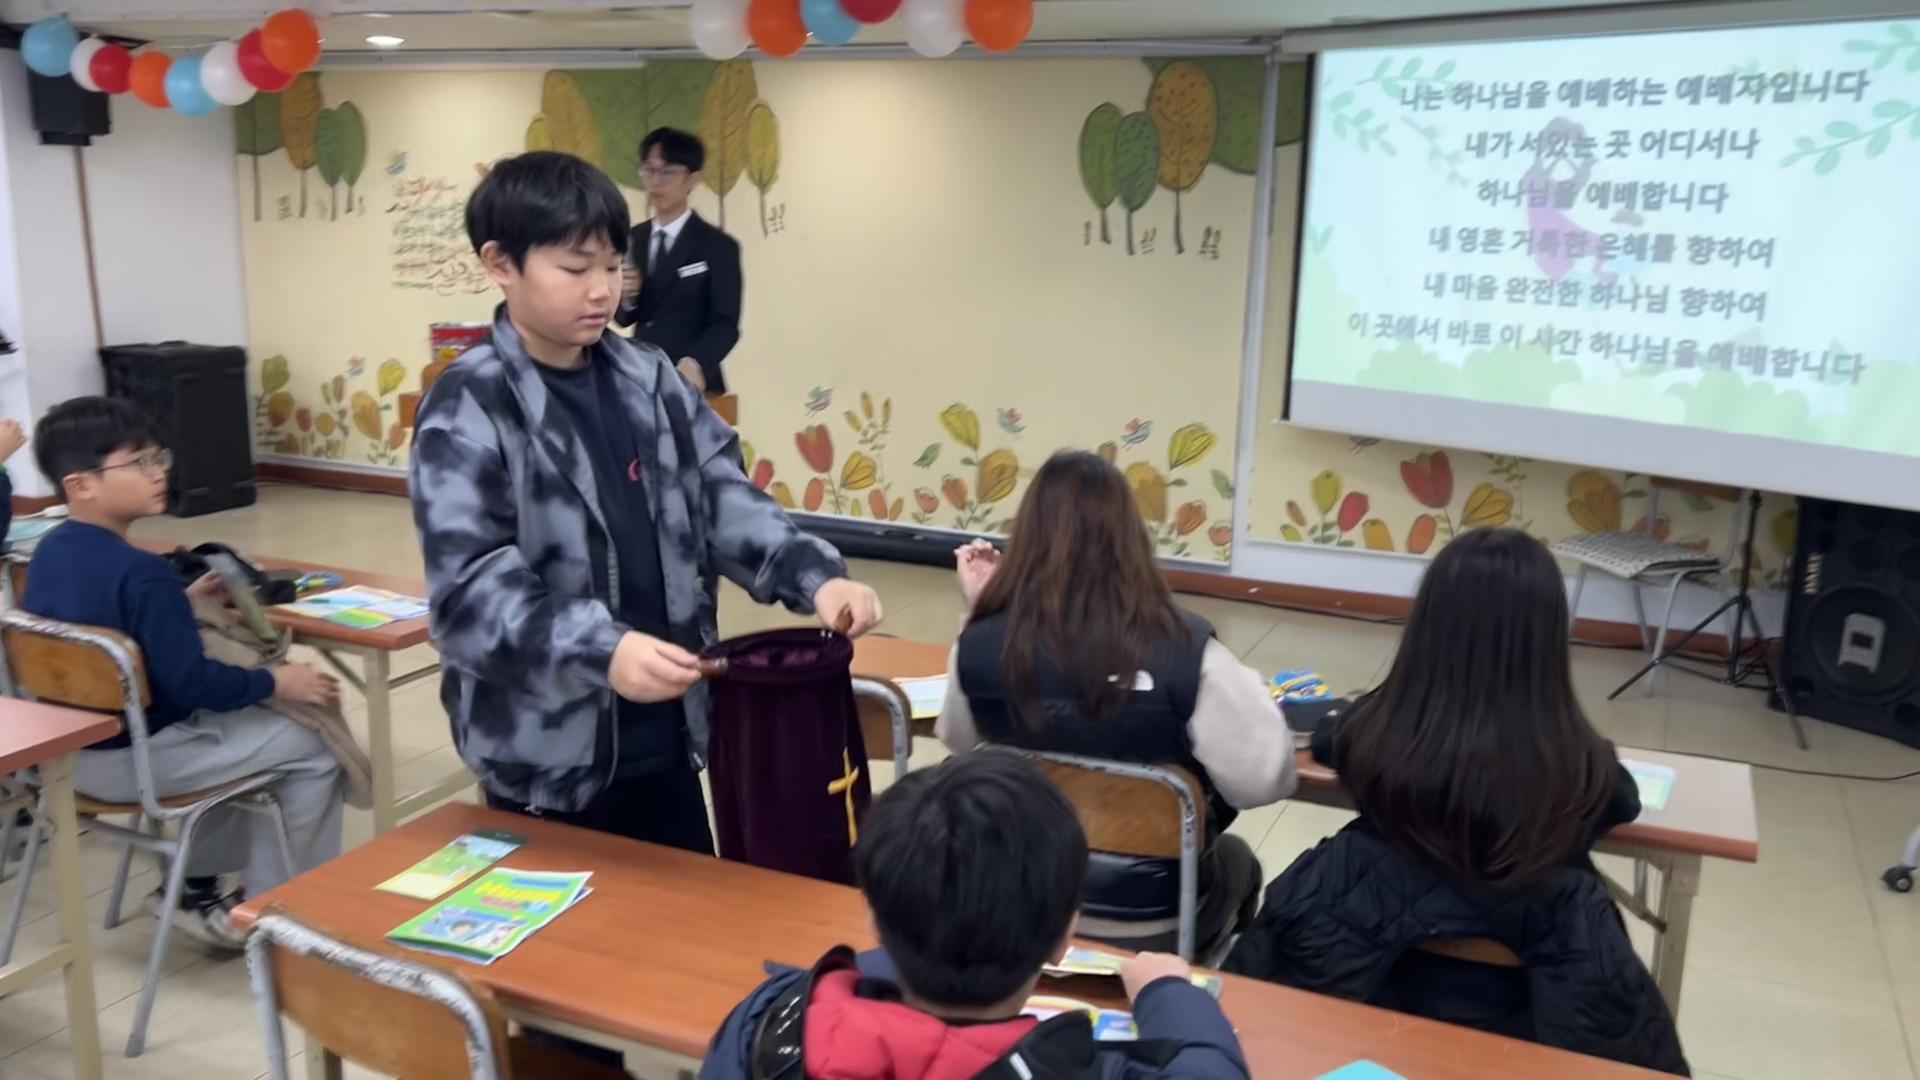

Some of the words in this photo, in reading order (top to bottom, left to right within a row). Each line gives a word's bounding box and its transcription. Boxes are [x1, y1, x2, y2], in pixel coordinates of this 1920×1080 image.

[1401, 82, 1444, 111] 나는
[1450, 80, 1550, 110] 하나님을
[1557, 78, 1667, 107] 예배하는
[1677, 70, 1869, 104] 예배자입니다
[1465, 130, 1513, 158] 내가
[1519, 129, 1598, 158] 서있는
[1605, 129, 1631, 158] 곳
[1639, 127, 1760, 159] 어디서나
[1478, 179, 1576, 209] 하나님을
[1586, 180, 1729, 213] 예배합니다
[1429, 226, 1450, 251] 내
[1457, 227, 1504, 254] 영혼
[1599, 232, 1677, 263] 은혜를
[1687, 235, 1776, 268] 향하여
[1424, 273, 1446, 298] 내
[1453, 274, 1498, 300] 마음
[1505, 276, 1581, 307] 완전한
[1591, 281, 1669, 314] 하나님
[1680, 287, 1767, 322] 향하여
[1349, 312, 1368, 337] 이
[1374, 313, 1440, 343] 곳에서
[1448, 320, 1492, 347] 바로
[1500, 324, 1522, 351] 이
[1531, 324, 1582, 356] 시간
[1590, 331, 1699, 368] 하나님을
[1707, 343, 1866, 384] 예배합니다
